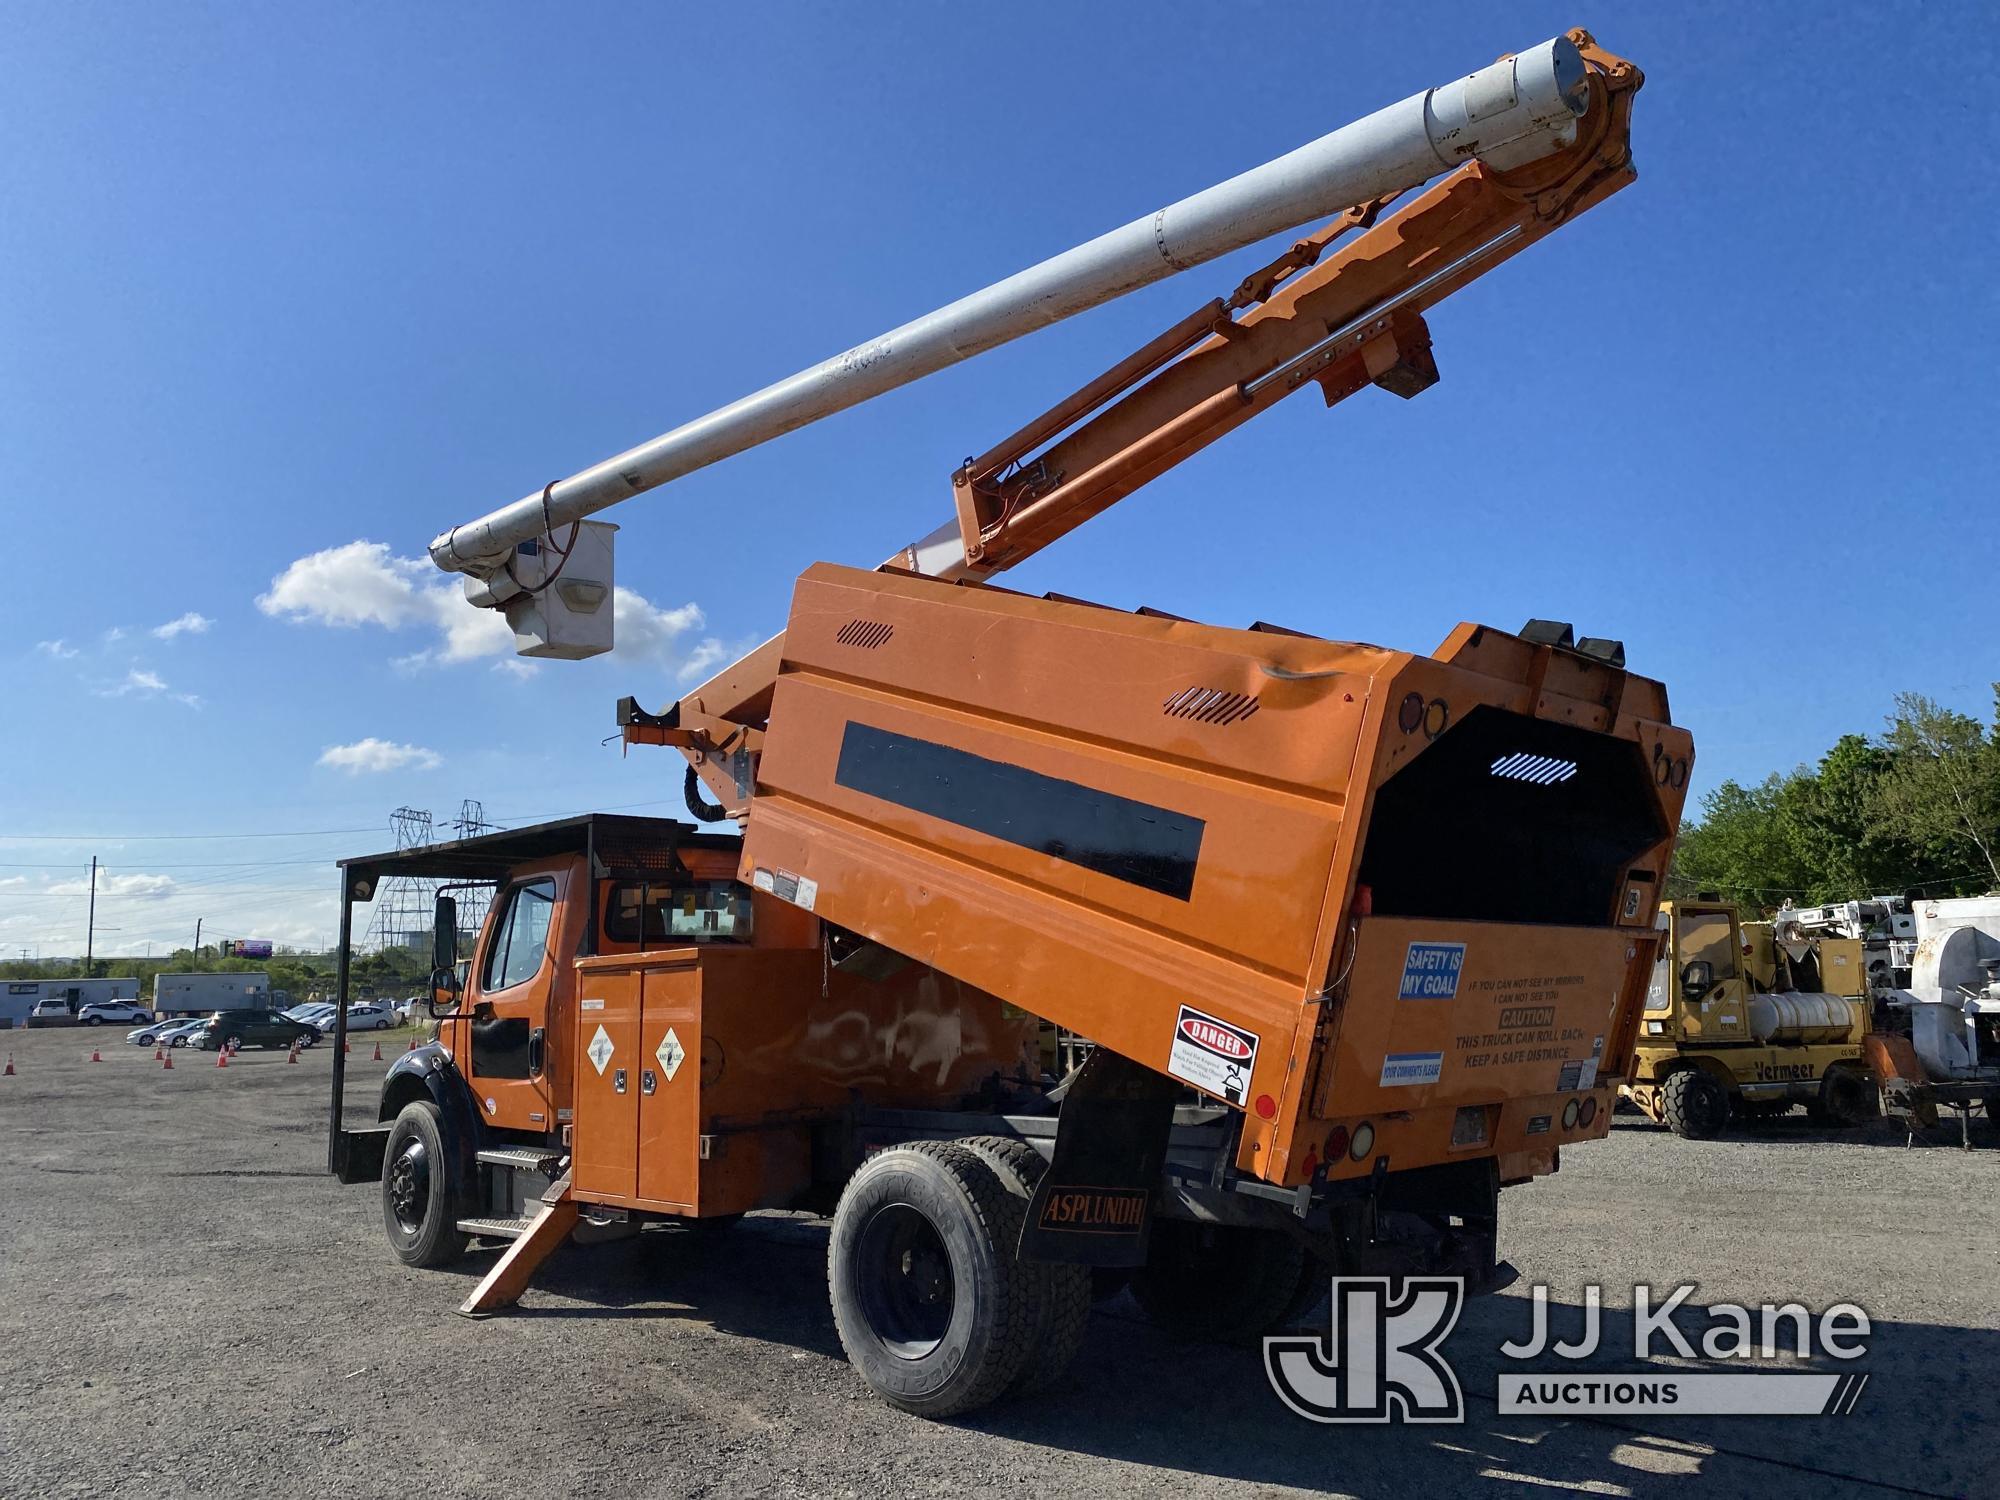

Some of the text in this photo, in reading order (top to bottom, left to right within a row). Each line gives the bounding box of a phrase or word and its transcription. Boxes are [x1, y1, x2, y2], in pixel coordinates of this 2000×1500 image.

[1408, 950, 1461, 970] SAFETY IS
[1403, 975, 1453, 994] MY GOAL
[1468, 982, 1478, 991] IF
[1480, 980, 1495, 990] YOU
[1496, 979, 1513, 990] CAN
[1514, 978, 1529, 988] NOT
[1529, 977, 1542, 987] SEE
[1498, 993, 1513, 1003] CAN
[1514, 992, 1529, 1003] NOT
[1530, 991, 1543, 1001] SEE
[1545, 991, 1559, 1000] YOU
[1502, 1008, 1553, 1027] CAUTION
[1191, 1022, 1241, 1055] DANGER
[1456, 1028, 1584, 1049] THIS TRUCK CAN ROLL BACK
[1465, 1047, 1570, 1068] KEEP A SAFE DISTANCE
[1422, 1063, 1440, 1077] PLEASE
[1755, 1061, 1815, 1080] Vermeer
[1045, 1194, 1144, 1225] ASPLUNDH
